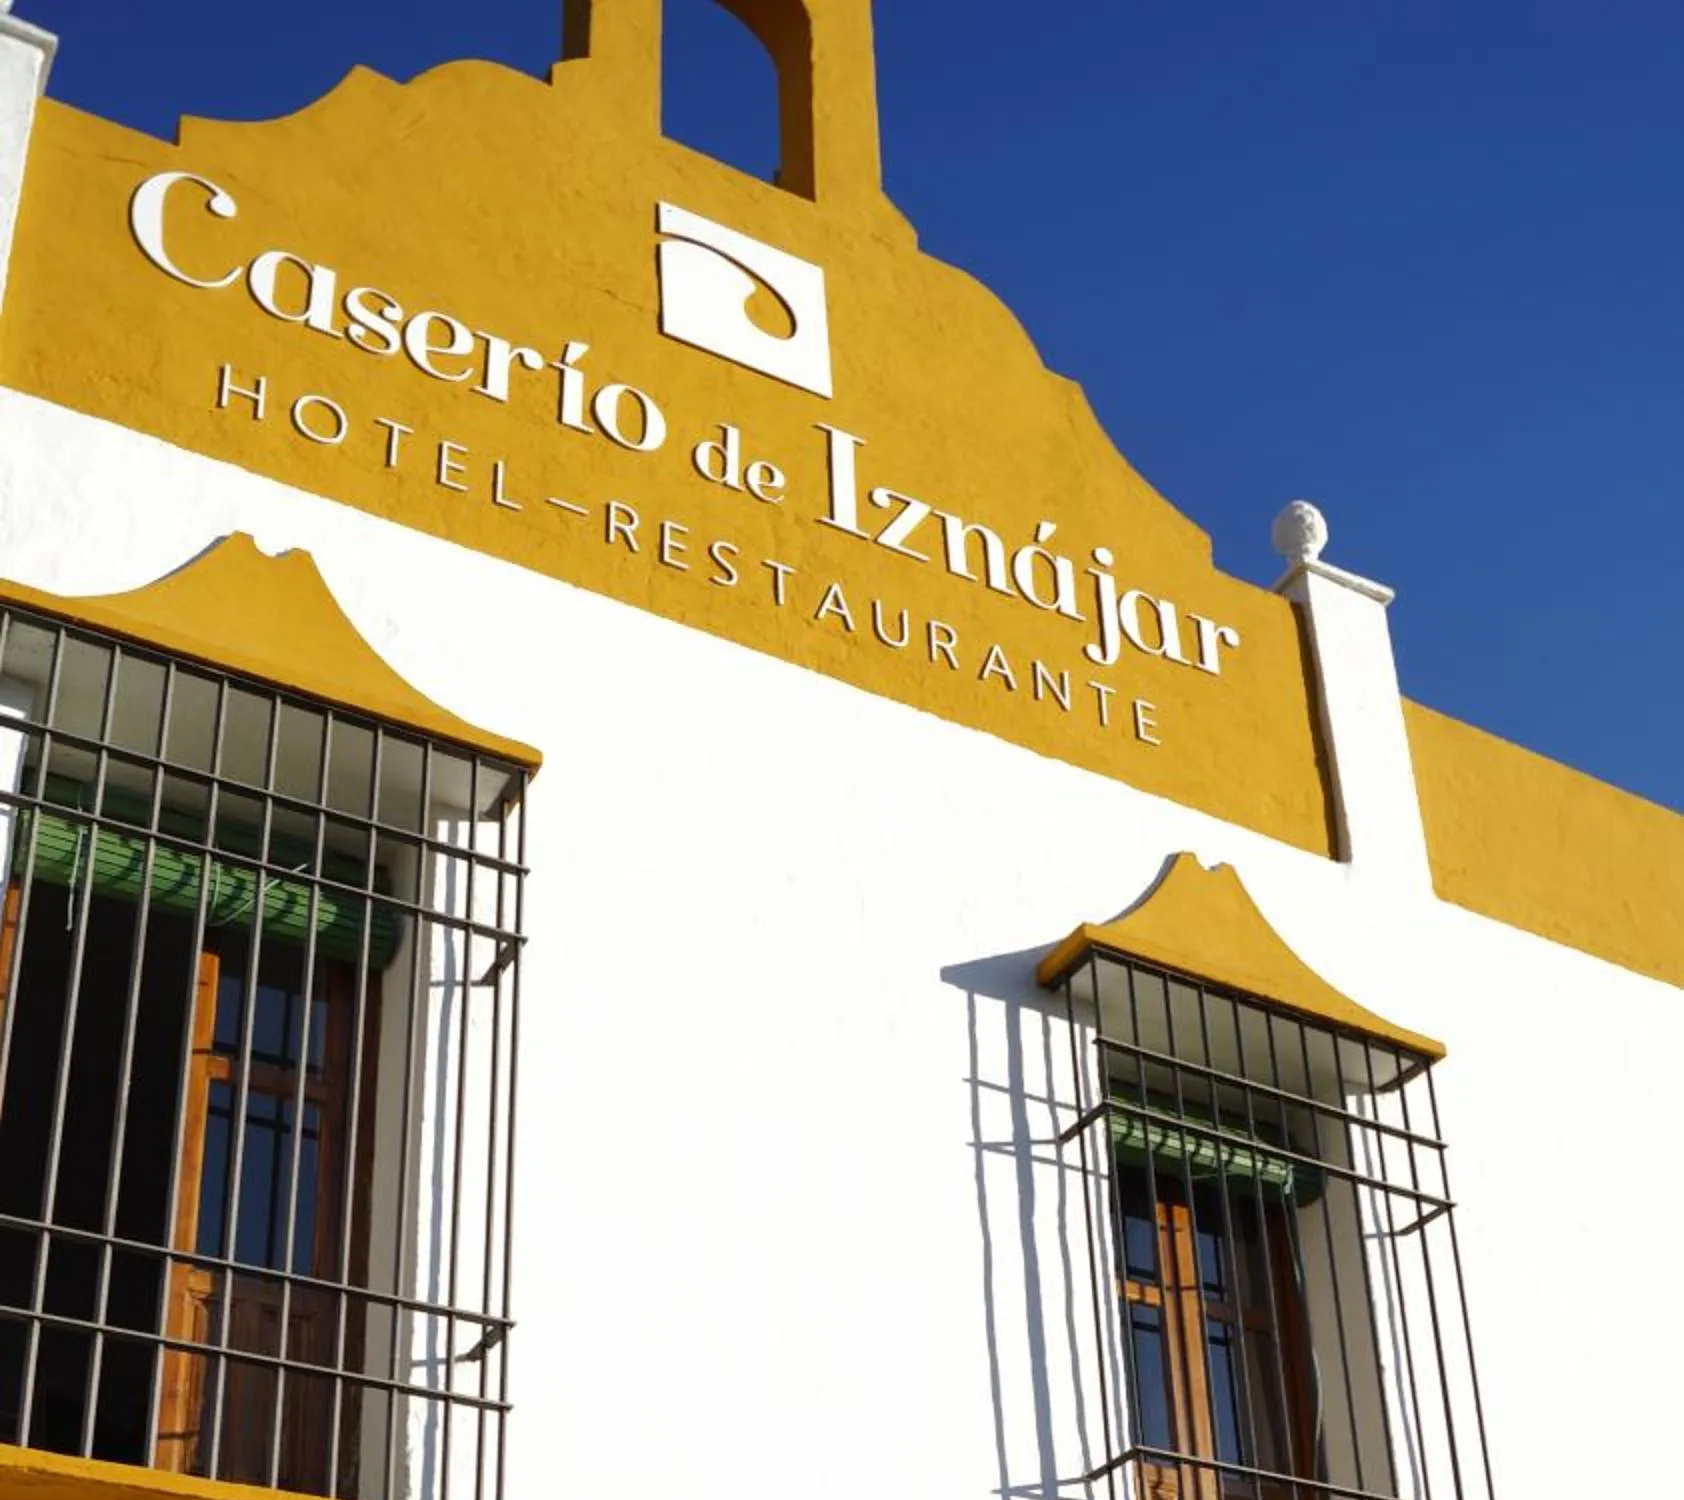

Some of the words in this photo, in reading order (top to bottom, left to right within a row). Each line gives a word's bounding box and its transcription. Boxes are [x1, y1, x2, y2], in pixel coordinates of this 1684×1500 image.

[130, 171, 668, 453] Caserío
[694, 423, 787, 503] de
[815, 422, 1242, 676] Iznájar
